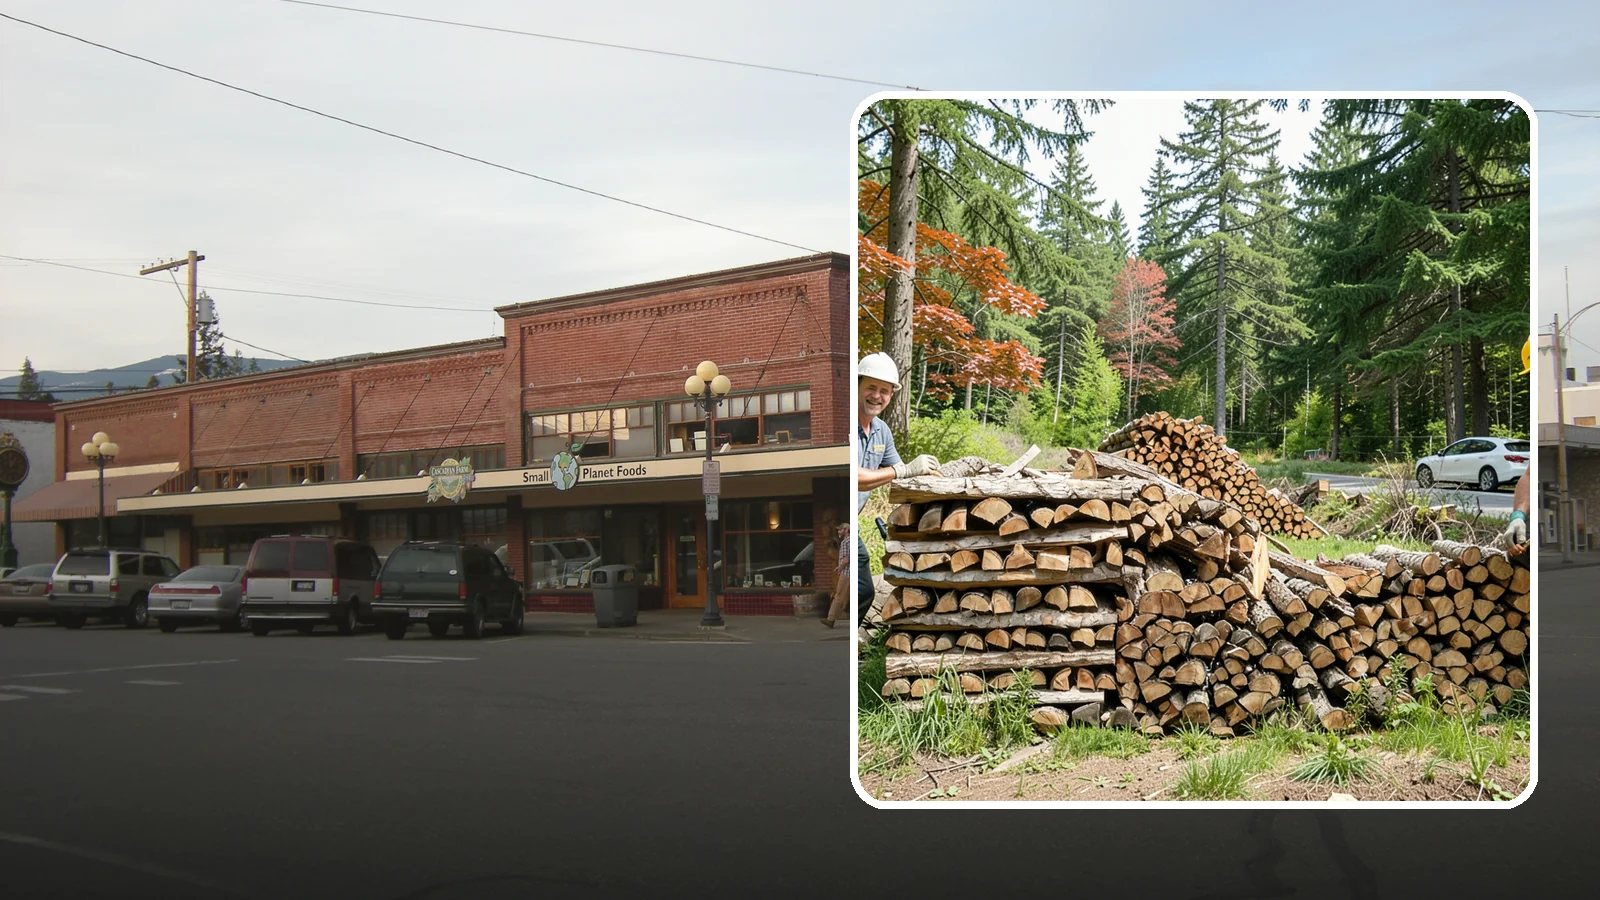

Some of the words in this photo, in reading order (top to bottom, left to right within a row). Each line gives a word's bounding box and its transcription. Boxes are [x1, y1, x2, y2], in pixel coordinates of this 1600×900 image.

[523, 472, 549, 483] Small
[583, 467, 614, 479] Planet
[617, 464, 647, 477] Foods
